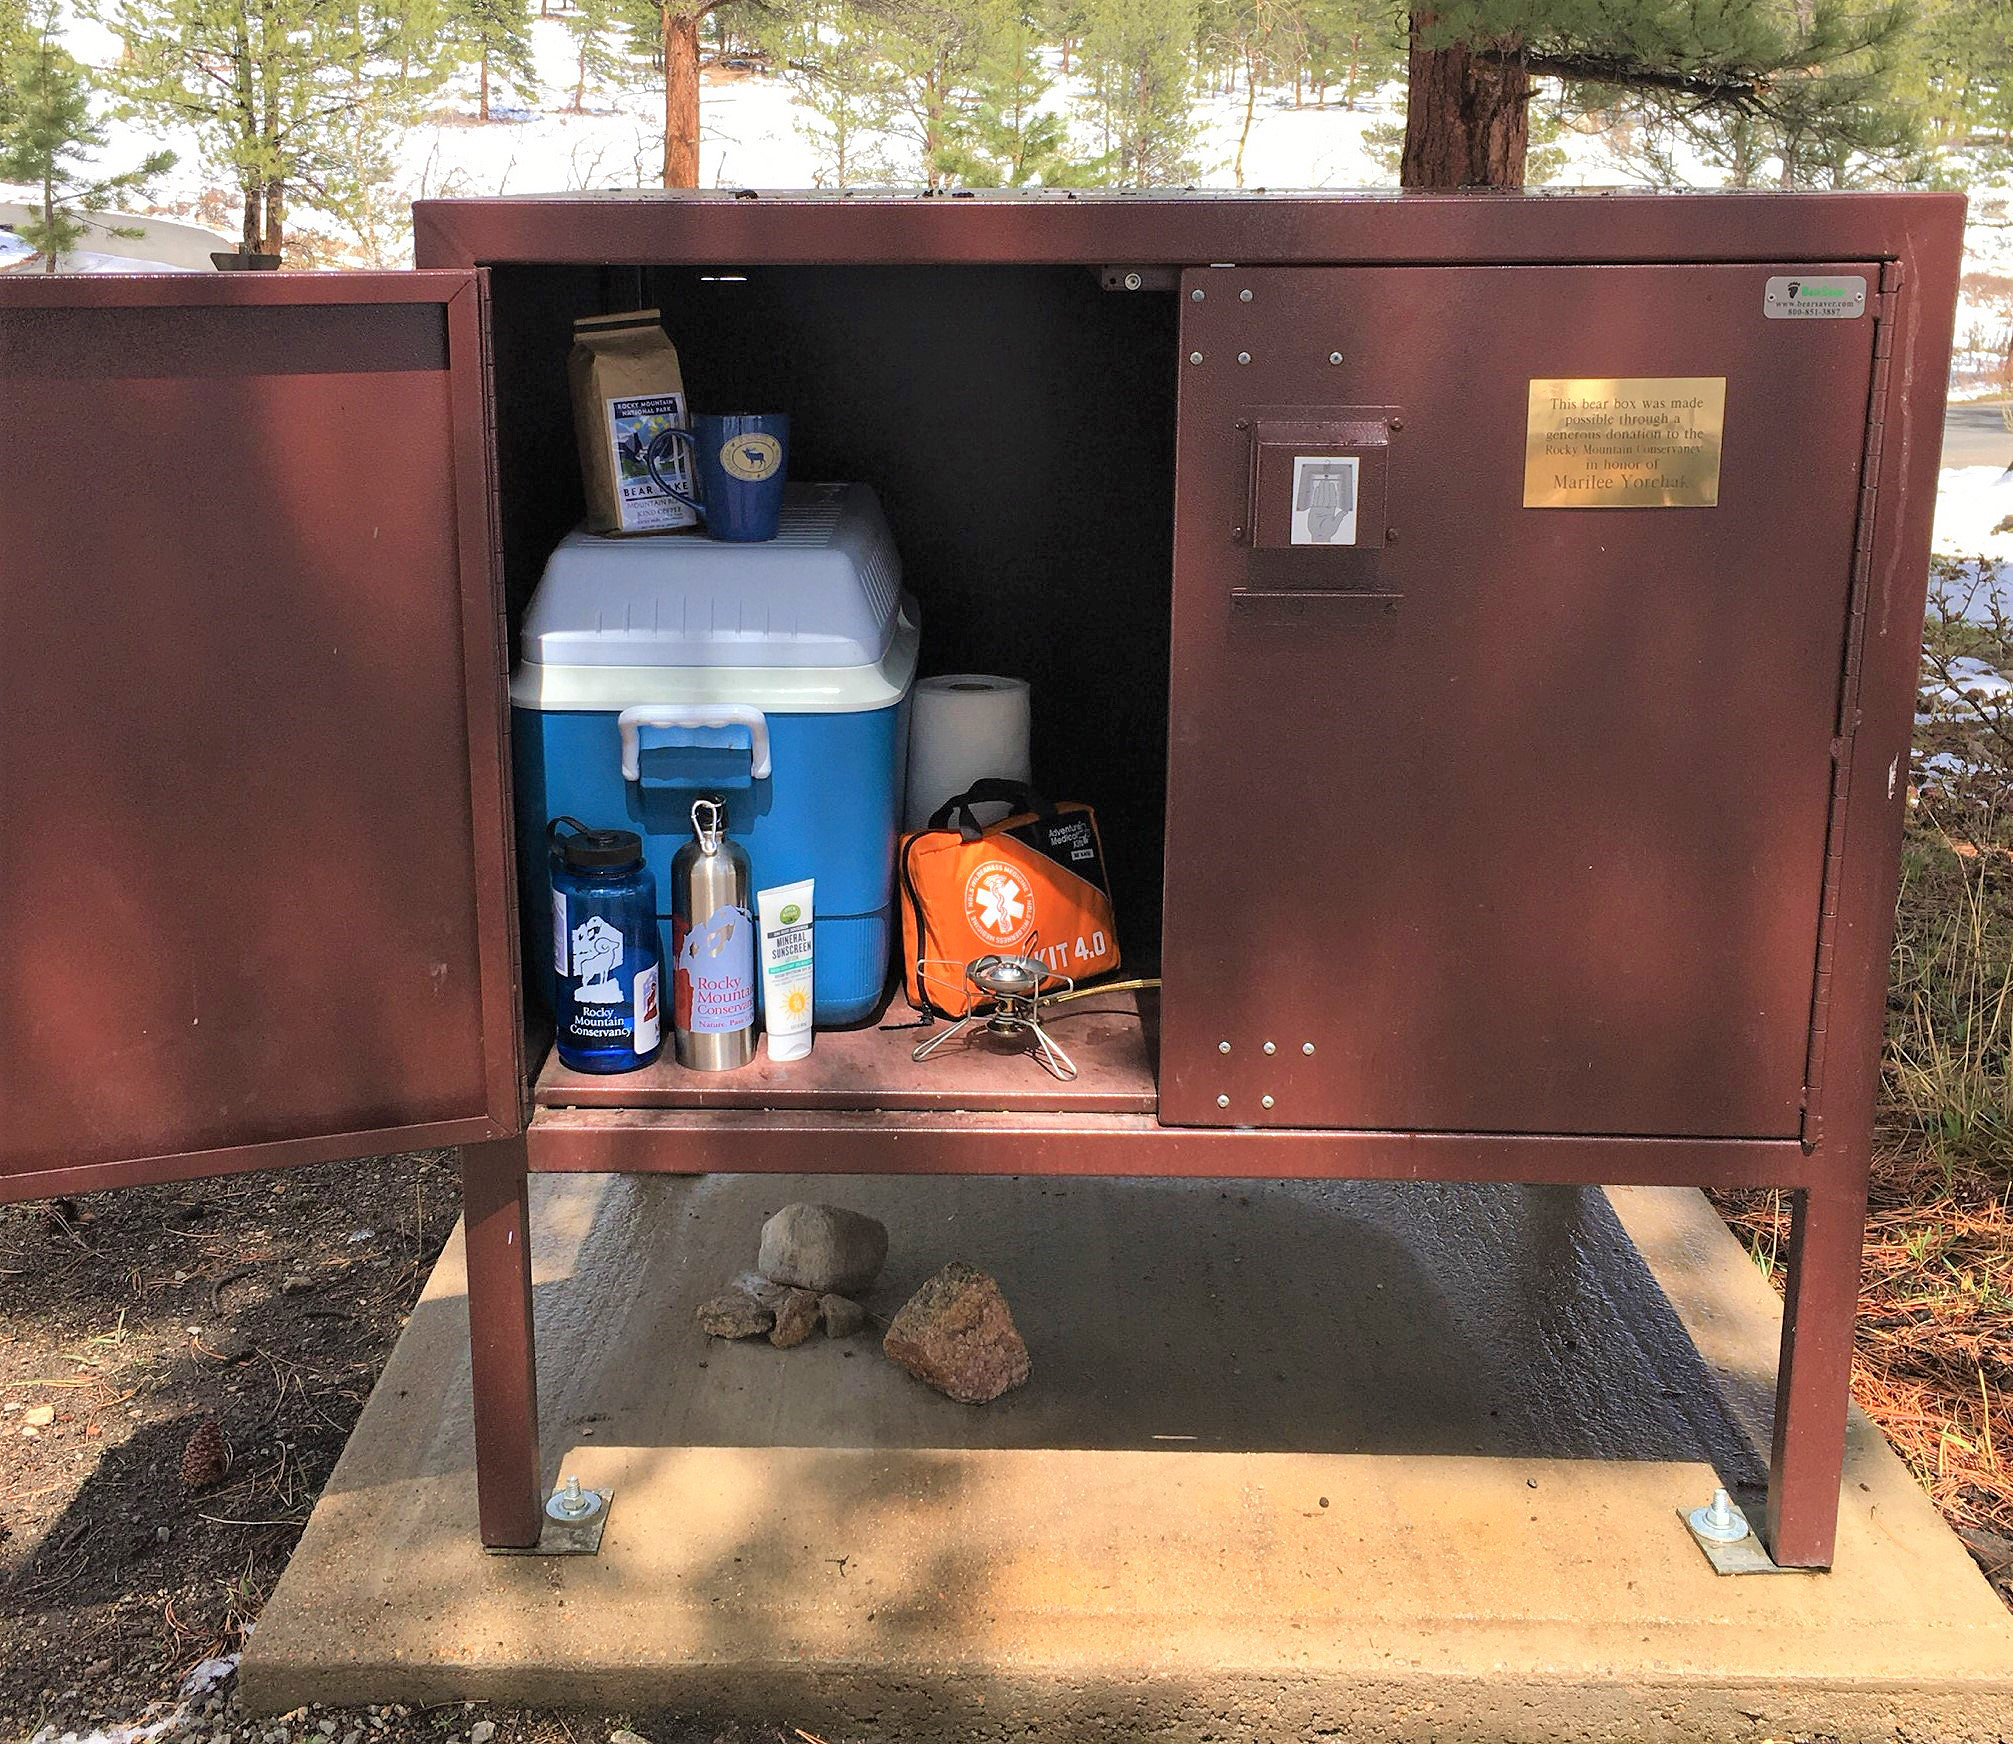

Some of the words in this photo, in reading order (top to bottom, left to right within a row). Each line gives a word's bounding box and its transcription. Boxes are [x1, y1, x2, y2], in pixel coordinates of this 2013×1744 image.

[1788, 308, 1841, 316] 800-851-3887
[617, 402, 639, 410] ROCKY
[640, 399, 674, 408] MOUNTAIN
[1551, 398, 1577, 410] This
[1583, 398, 1609, 409] bear
[1614, 398, 1636, 409] box
[1642, 399, 1666, 409] was
[1671, 397, 1704, 409] made
[622, 408, 655, 417] NATIONAL
[1565, 413, 1614, 427] possible
[1620, 412, 1669, 427] through
[1673, 415, 1681, 424] a
[1546, 430, 1601, 442] generous
[1606, 428, 1661, 440] donation
[1667, 429, 1679, 439] to
[1684, 427, 1704, 439] the
[1545, 443, 1578, 457] Rocky
[1583, 443, 1632, 455] Mountain
[1636, 444, 1704, 457] Conservancy
[1586, 459, 1598, 470] in
[1603, 458, 1640, 470] honor
[1645, 458, 1661, 470] of
[623, 485, 654, 497] BEAR
[660, 481, 689, 494] LKE
[1553, 474, 1614, 489] Marilee
[1620, 474, 1690, 489] Yorchak
[626, 499, 668, 510] MOUNTAIN
[1048, 822, 1083, 838] Adventure
[1050, 831, 1080, 846] Medical
[971, 864, 1003, 889] WILDERNESS
[1003, 866, 1029, 893] MEDICINE
[776, 931, 807, 948] MINERAL
[1074, 931, 1106, 961] 4.0
[771, 940, 812, 960] SUNSCREEN
[697, 975, 742, 992] Rocky
[574, 1014, 624, 1027] Mountain
[583, 1006, 615, 1020] Rocky
[569, 1023, 633, 1038] Conservancy
